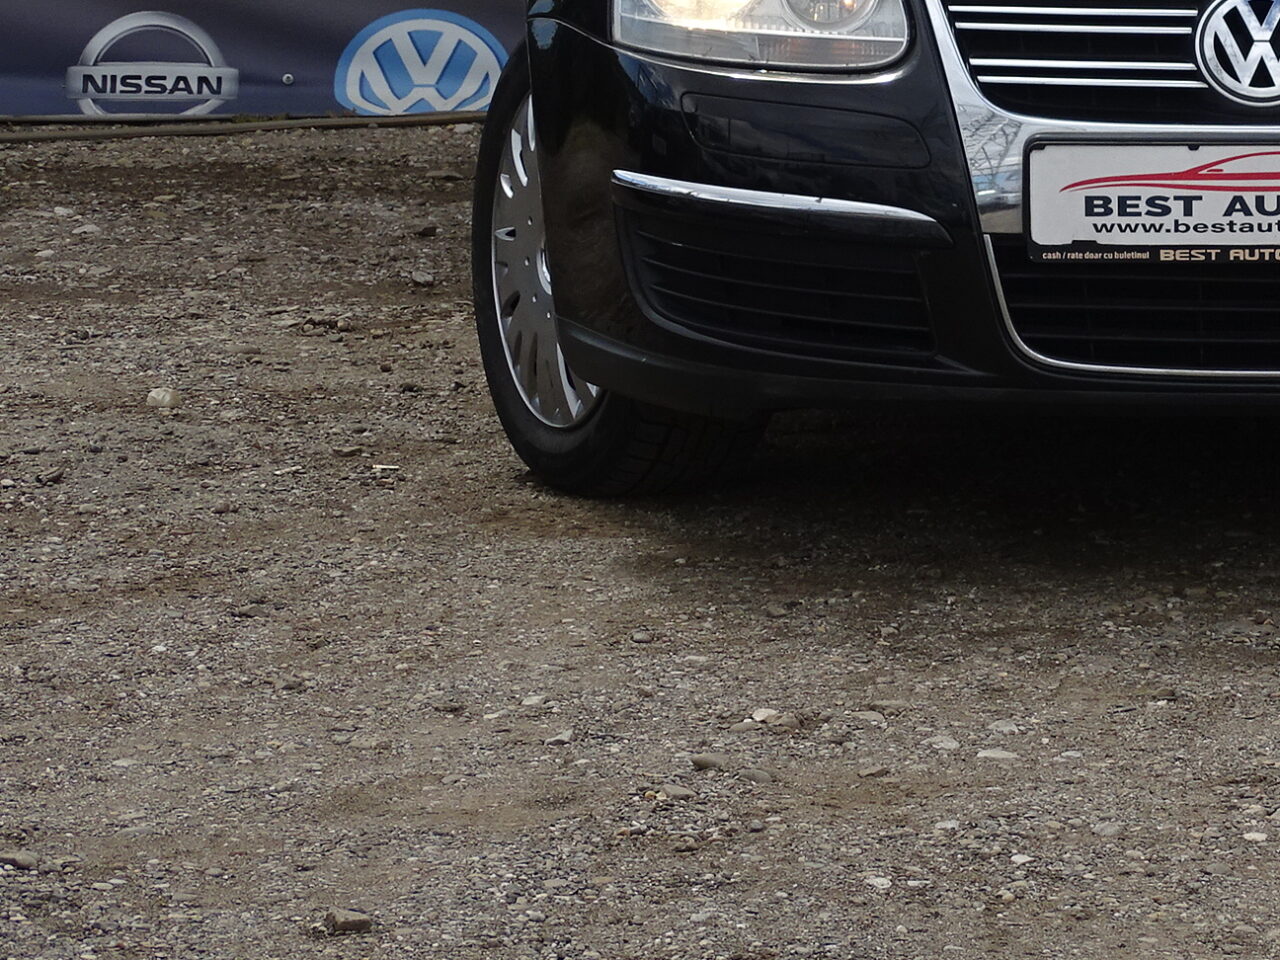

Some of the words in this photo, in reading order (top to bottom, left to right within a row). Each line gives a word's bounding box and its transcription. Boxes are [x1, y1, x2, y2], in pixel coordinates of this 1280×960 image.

[81, 73, 223, 96] NISSAN
[1084, 194, 1203, 218] BEST
[1042, 251, 1061, 259] cash
[1084, 251, 1102, 259] doar
[1159, 248, 1221, 261] BEST
